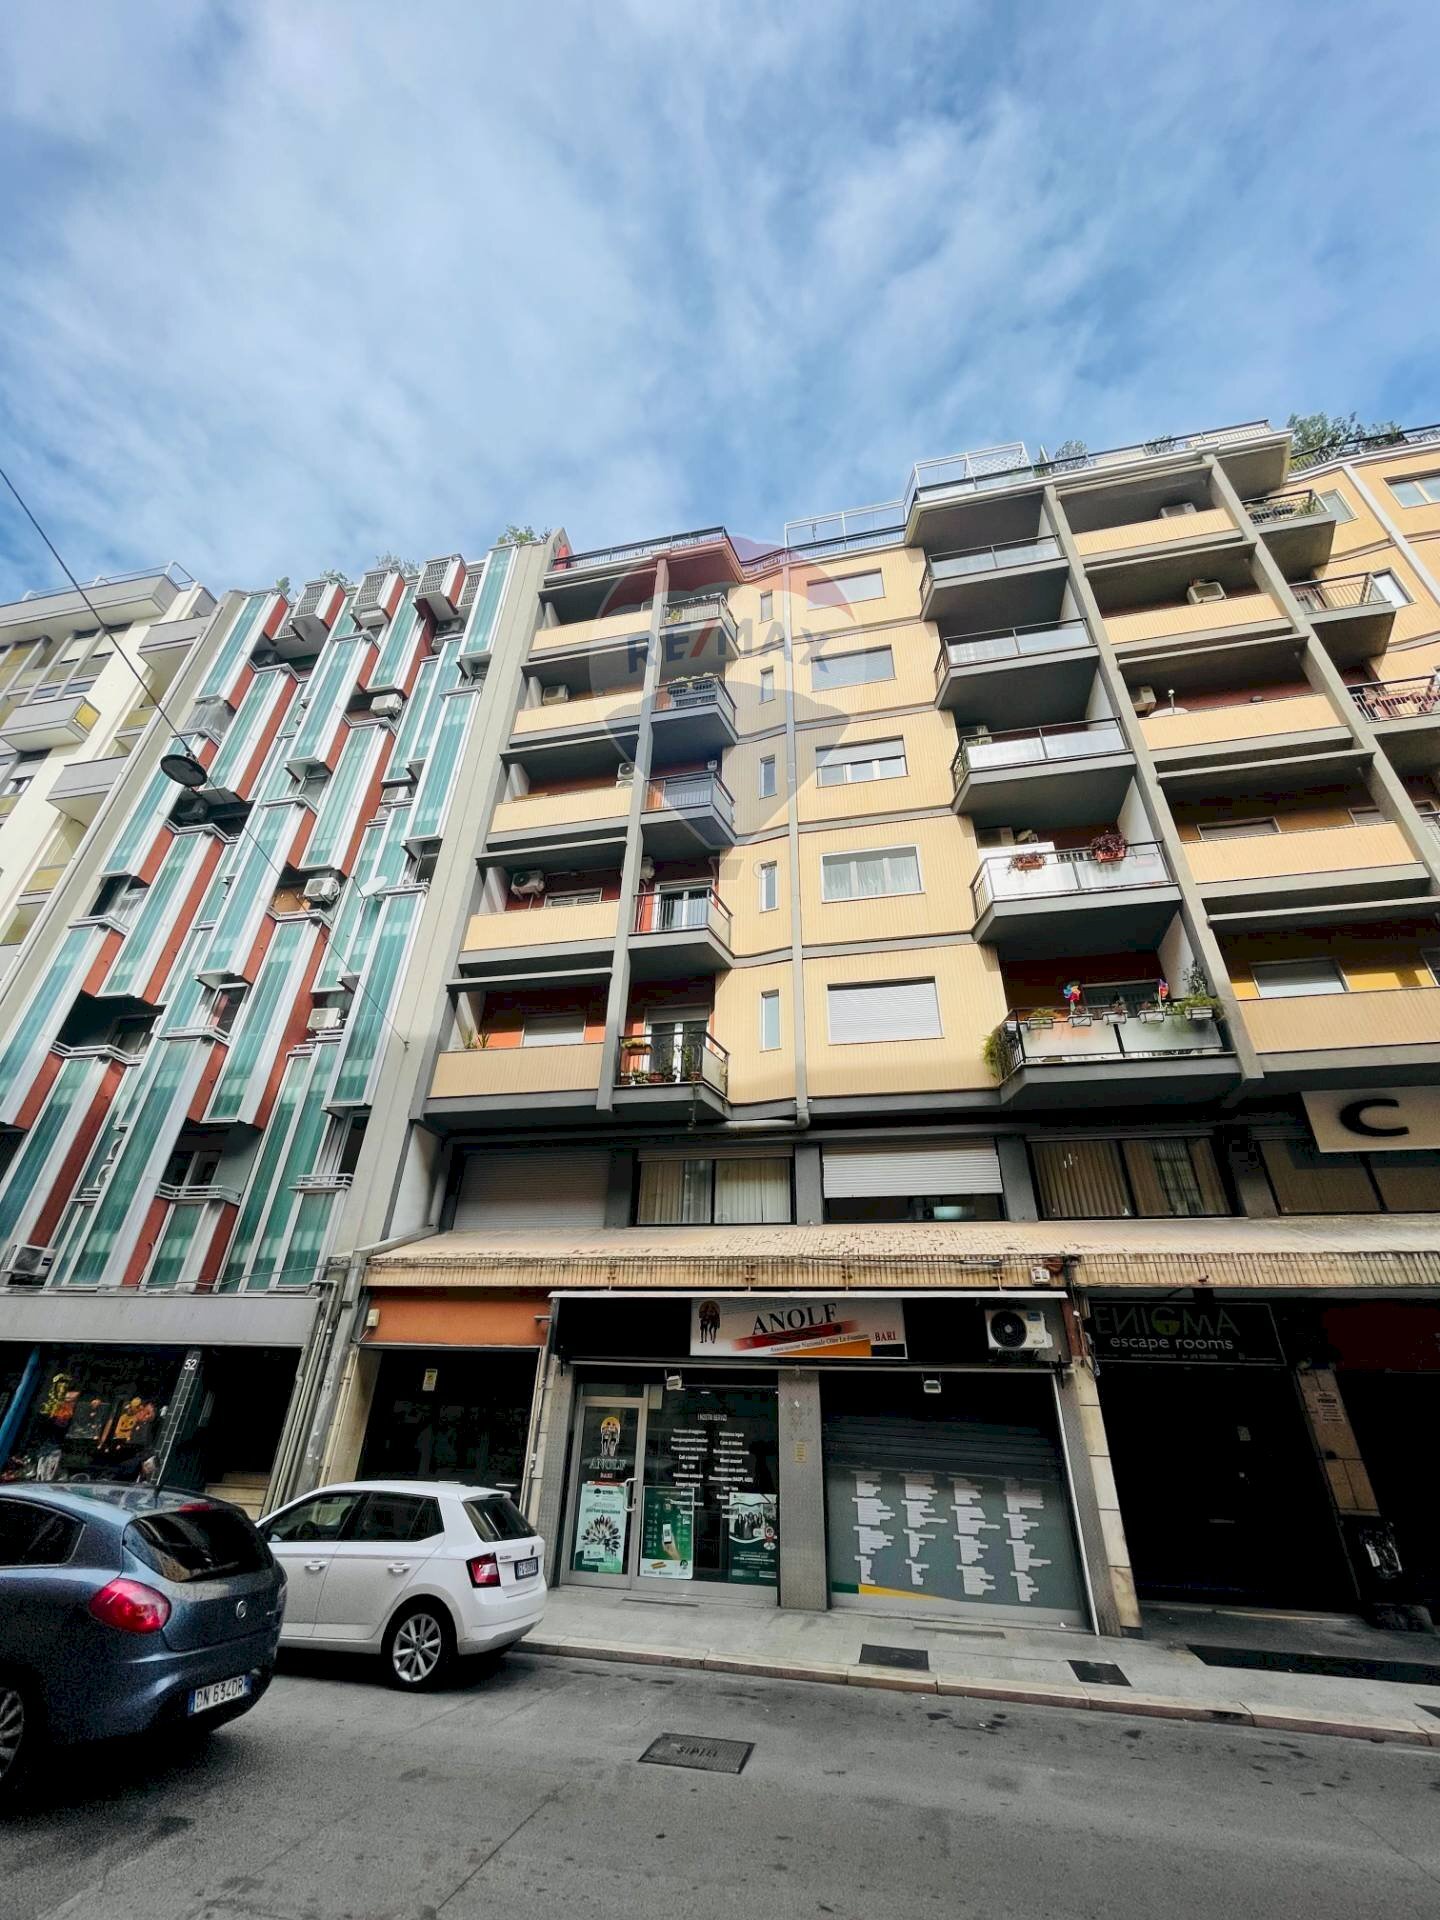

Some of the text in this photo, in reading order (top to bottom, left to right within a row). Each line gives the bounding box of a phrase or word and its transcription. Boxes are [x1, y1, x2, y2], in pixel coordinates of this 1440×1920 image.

[1340, 1098, 1409, 1136] C
[752, 1302, 837, 1335] ANOLF
[874, 1331, 896, 1342] BARI
[1110, 1336, 1234, 1351] escape rooms
[183, 1358, 198, 1371] 52
[589, 1459, 626, 1471] ANOLF
